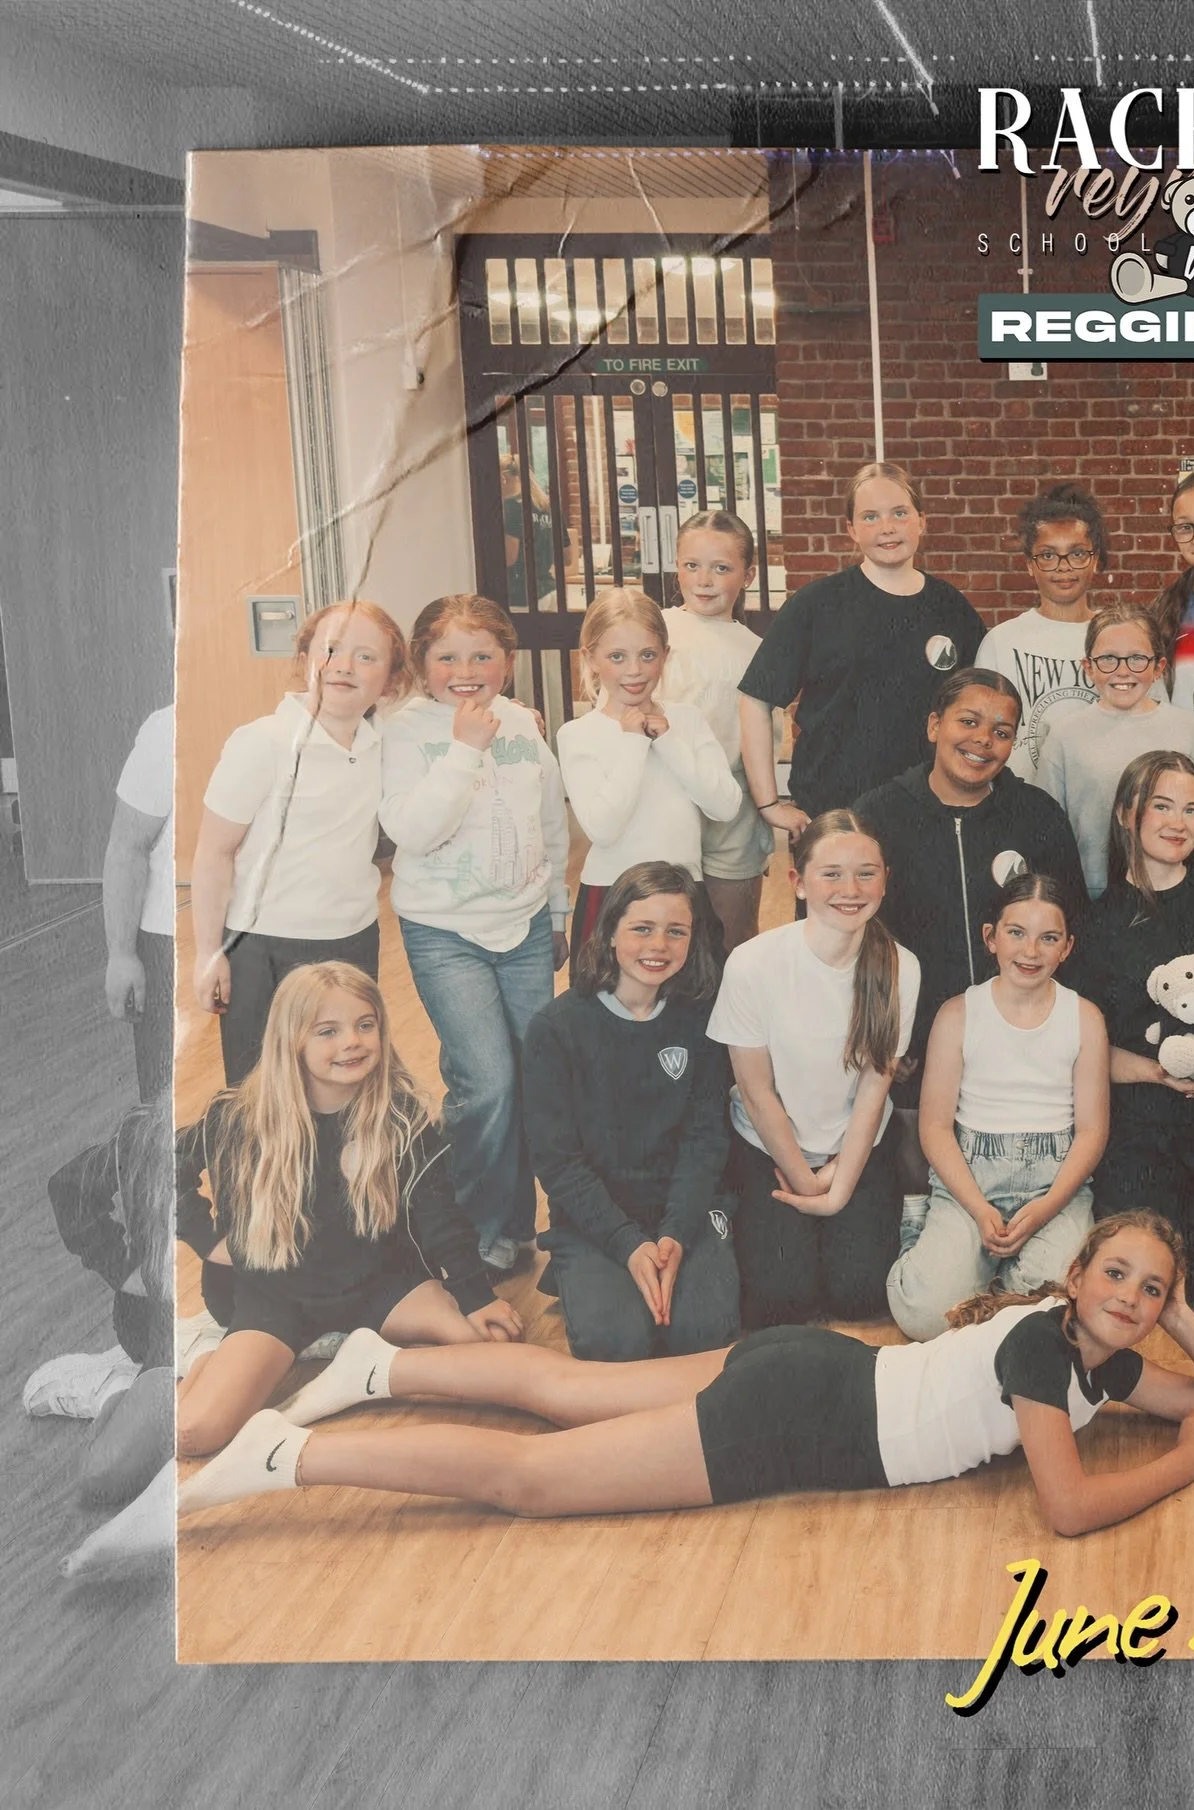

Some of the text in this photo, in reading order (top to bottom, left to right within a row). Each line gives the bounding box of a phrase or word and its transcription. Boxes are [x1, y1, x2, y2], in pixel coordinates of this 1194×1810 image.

[603, 358, 700, 372] TO FIRE EXIT
[1013, 648, 1065, 726] NEW
[664, 1053, 683, 1069] W
